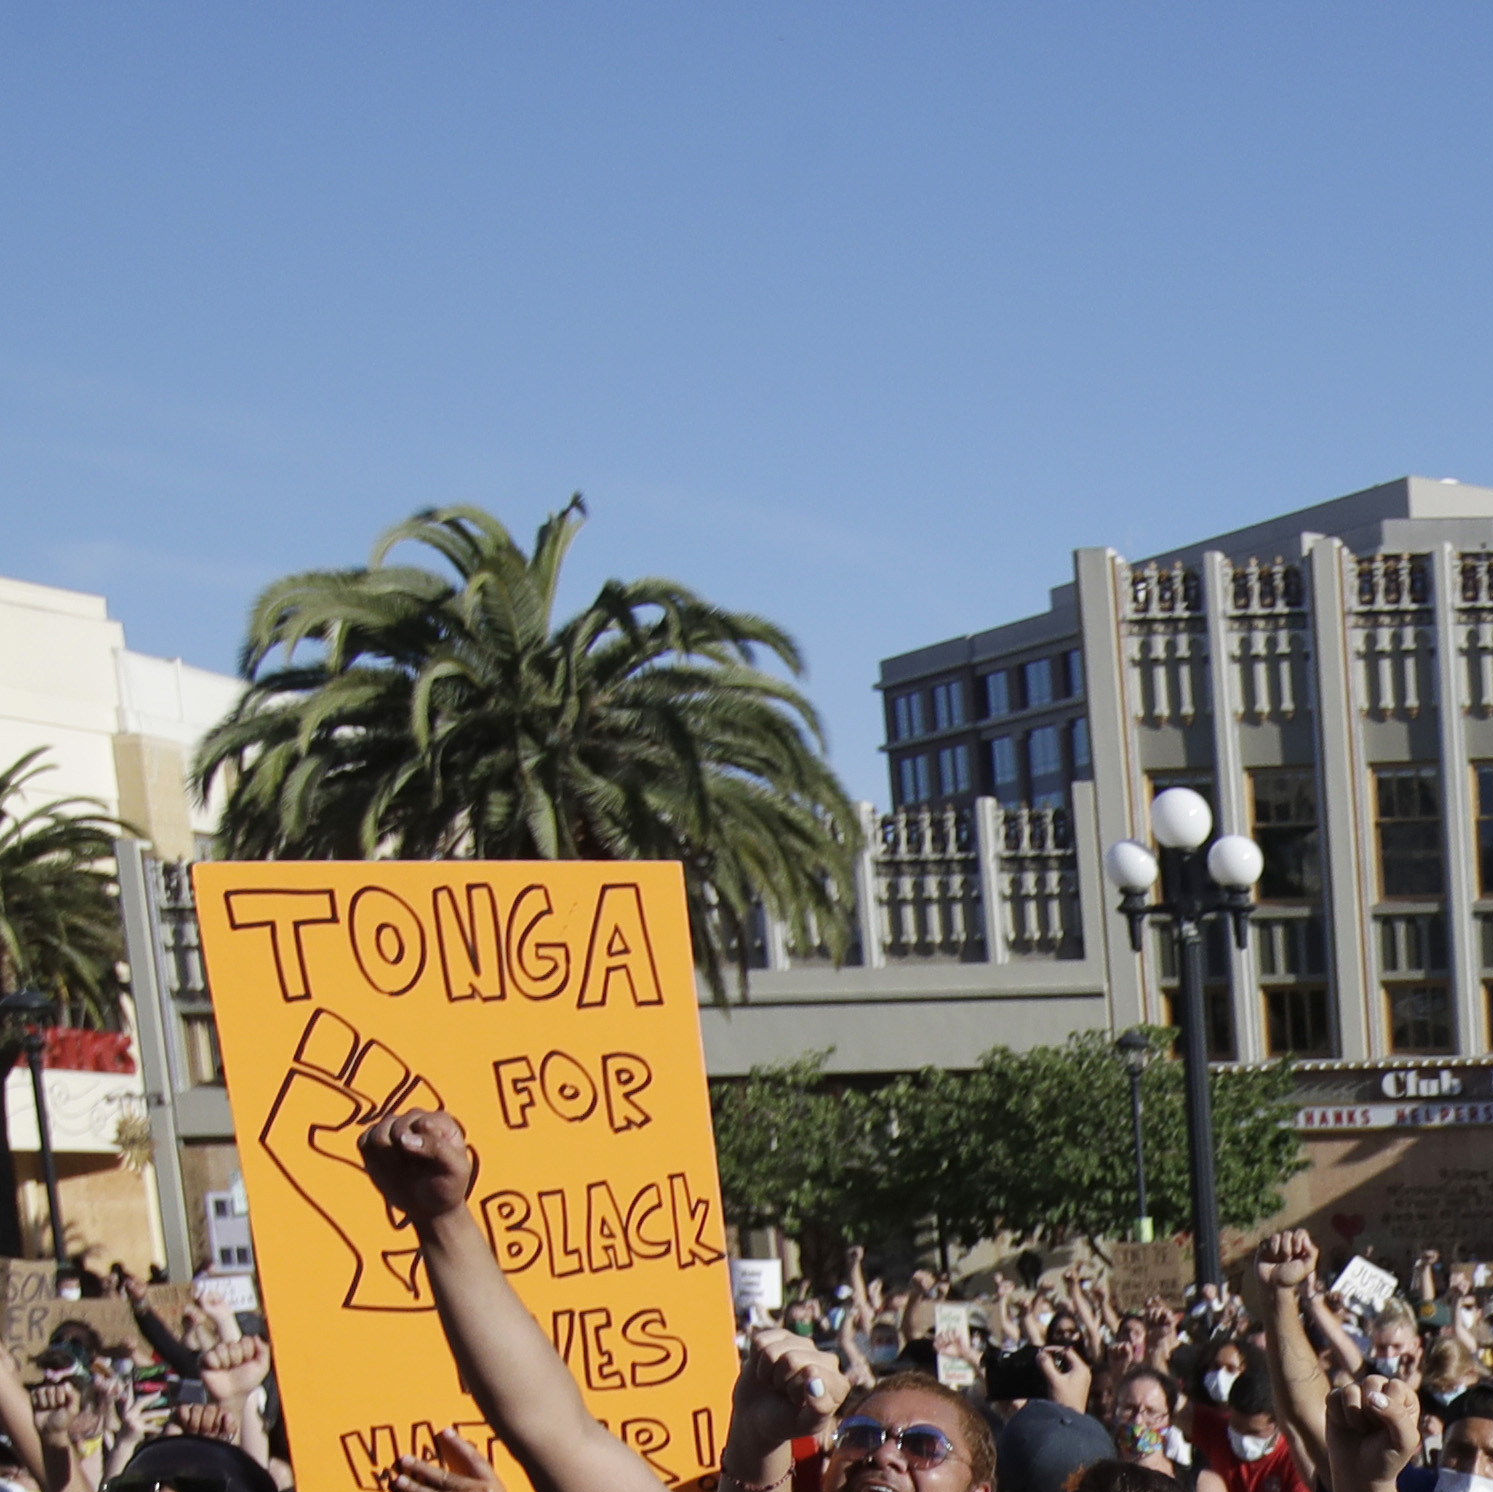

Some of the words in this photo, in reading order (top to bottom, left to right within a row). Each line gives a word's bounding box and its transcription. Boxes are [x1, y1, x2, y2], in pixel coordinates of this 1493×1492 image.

[223, 883, 663, 1009] TONGA
[494, 1051, 653, 1133] FOR
[1303, 1109, 1372, 1127] HANKS
[1396, 1103, 1493, 1124] HELPERS
[1381, 1068, 1463, 1099] Club
[480, 1174, 726, 1278] BLACK
